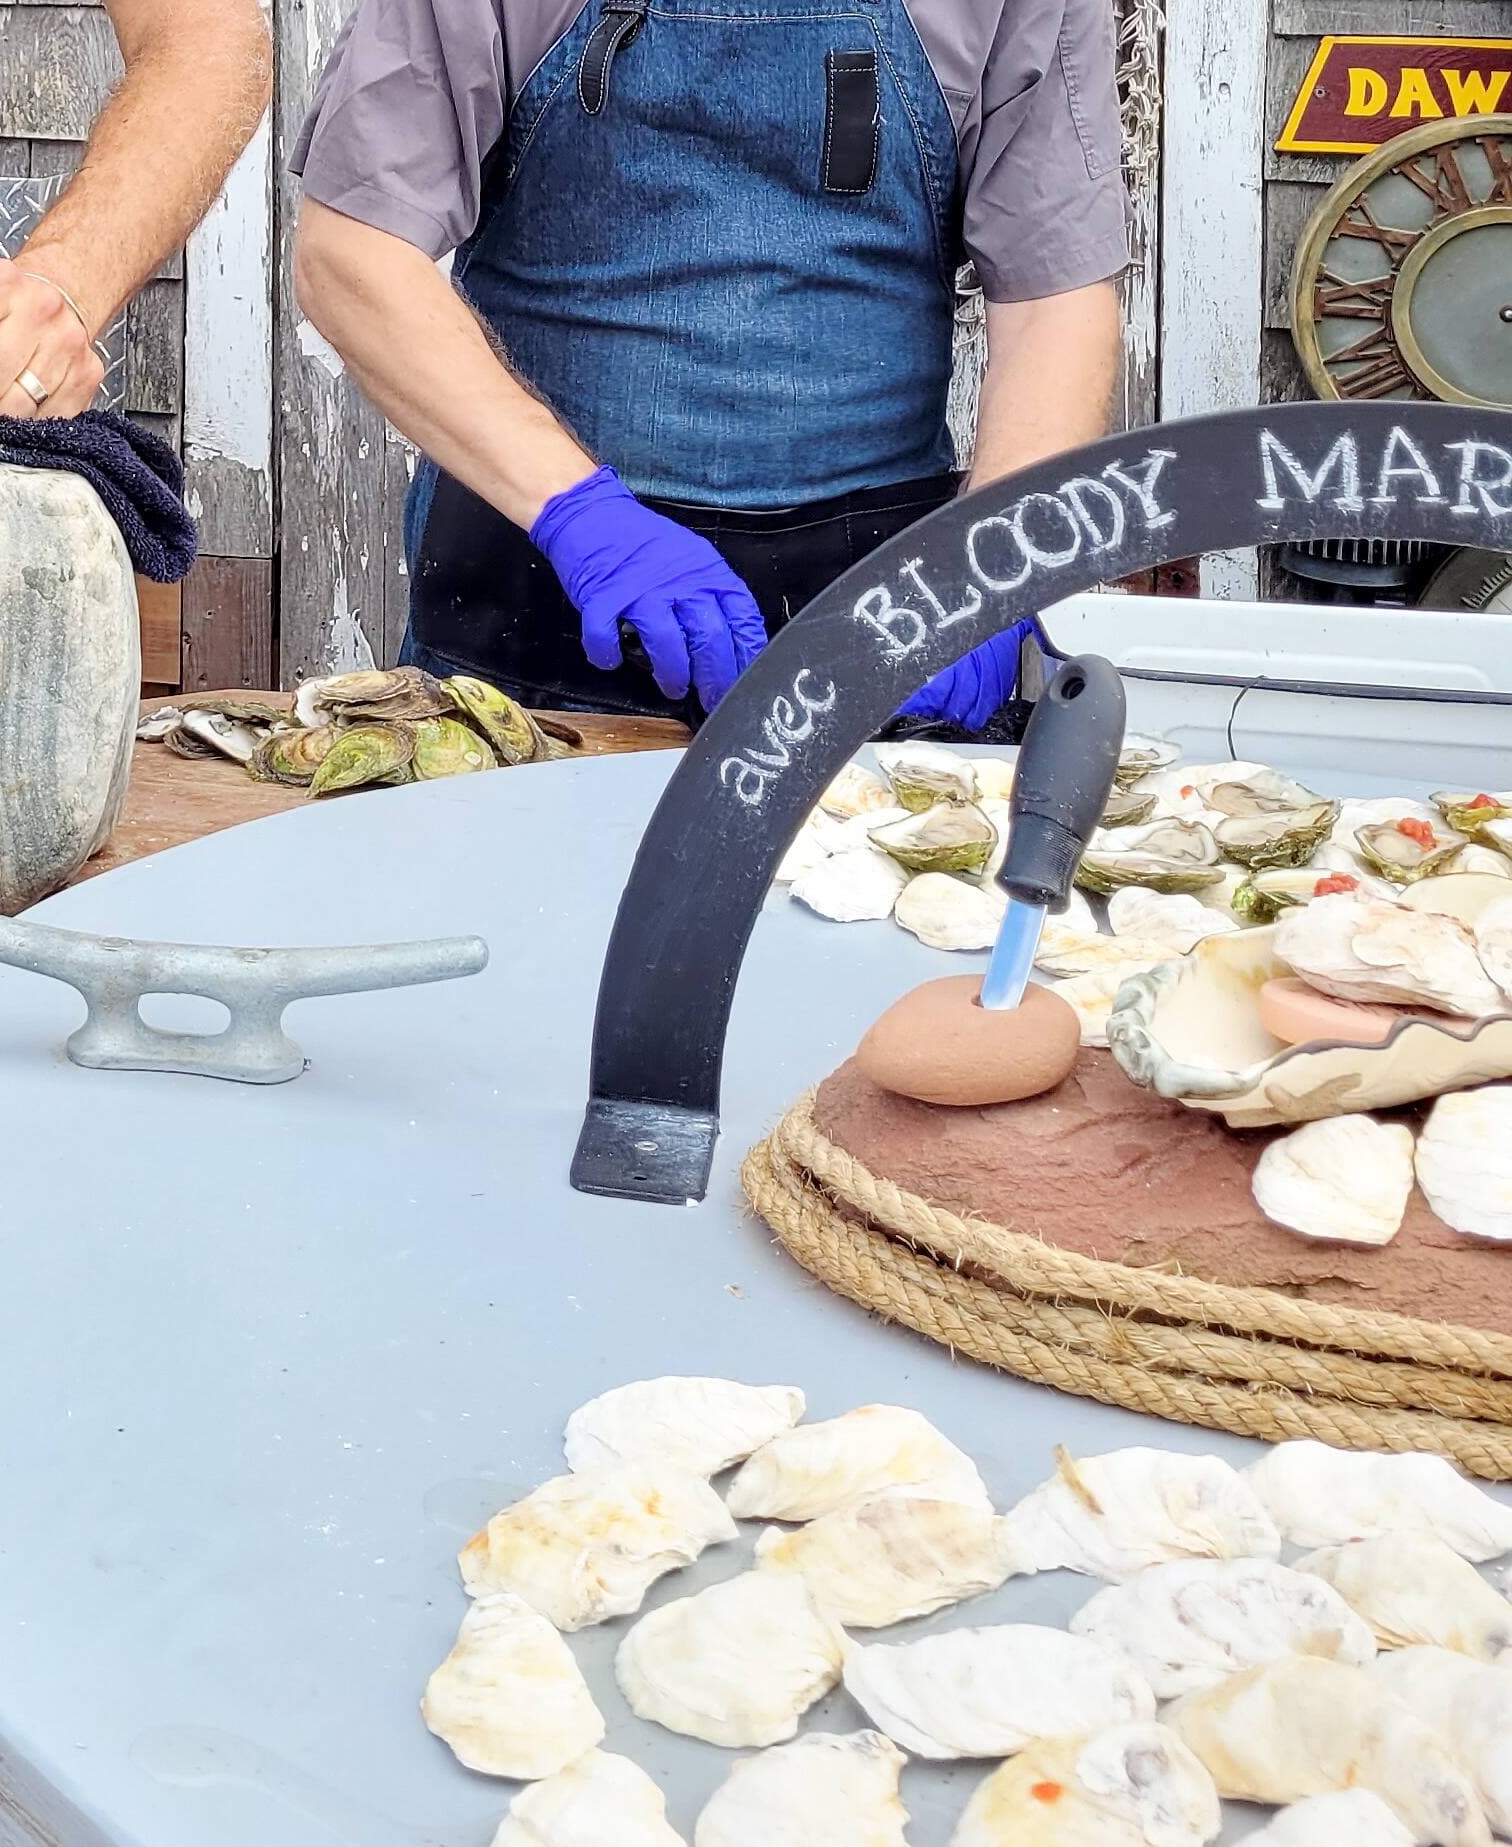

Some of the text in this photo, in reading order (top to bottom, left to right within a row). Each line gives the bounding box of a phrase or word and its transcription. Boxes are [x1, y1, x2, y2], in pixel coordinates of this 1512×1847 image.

[1344, 68, 1511, 118] DAW
[852, 449, 1178, 660] BLOODY
[718, 668, 836, 808] avec
